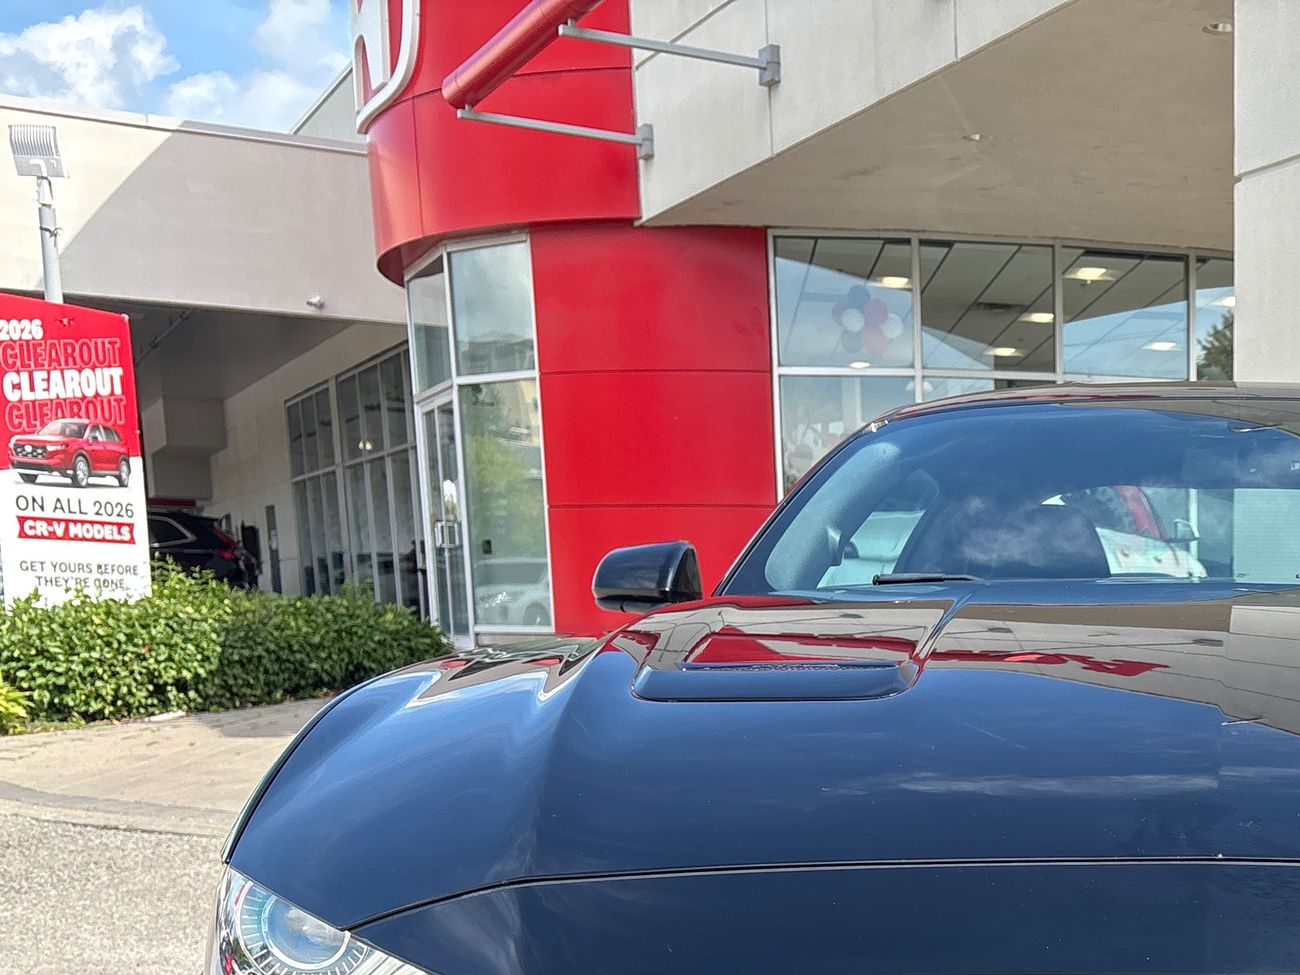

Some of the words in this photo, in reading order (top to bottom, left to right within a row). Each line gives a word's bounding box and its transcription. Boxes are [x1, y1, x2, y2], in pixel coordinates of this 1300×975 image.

[0, 318, 43, 340] 2026
[1, 338, 120, 371] CLEAROUT
[3, 367, 123, 402] CLEAROUT
[16, 495, 45, 512] ON
[53, 497, 88, 515] ALL
[93, 500, 134, 518] 2026
[23, 519, 66, 538] CR-V
[68, 522, 131, 541] MODELS
[20, 560, 46, 572] GET
[50, 562, 93, 574] YOURS
[35, 575, 90, 588] THEY'RE
